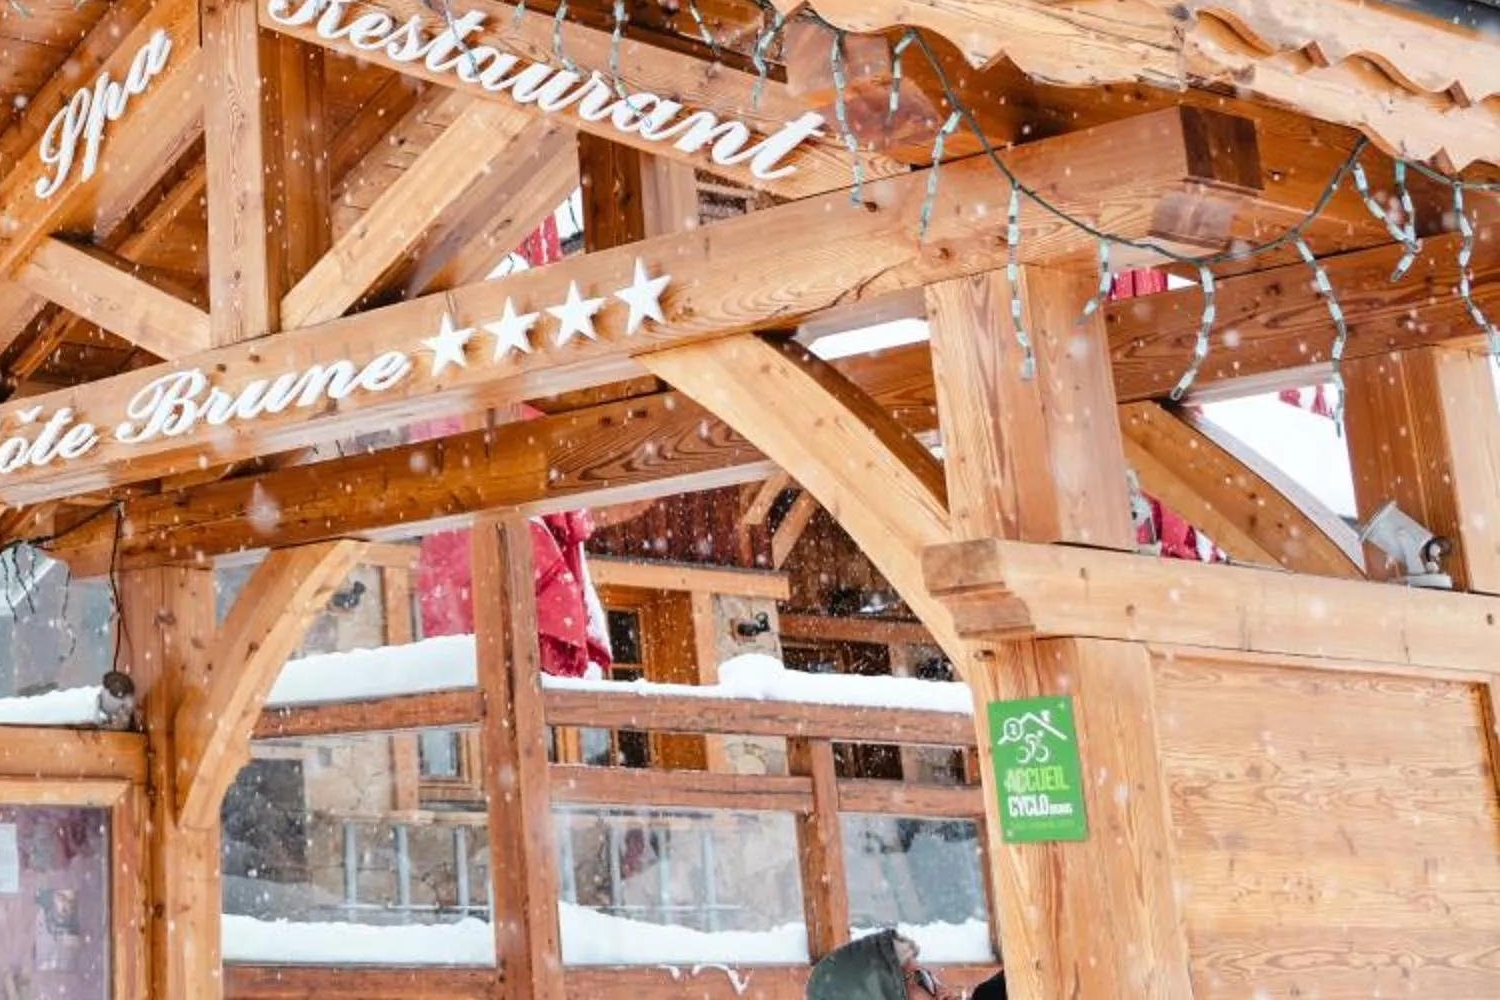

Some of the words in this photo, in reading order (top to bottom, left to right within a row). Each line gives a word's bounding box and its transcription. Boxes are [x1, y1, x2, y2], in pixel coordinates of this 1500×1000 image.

[34, 28, 172, 199] Spa
[114, 350, 413, 444] Brune
[1004, 765, 1070, 793] ACCUEIL
